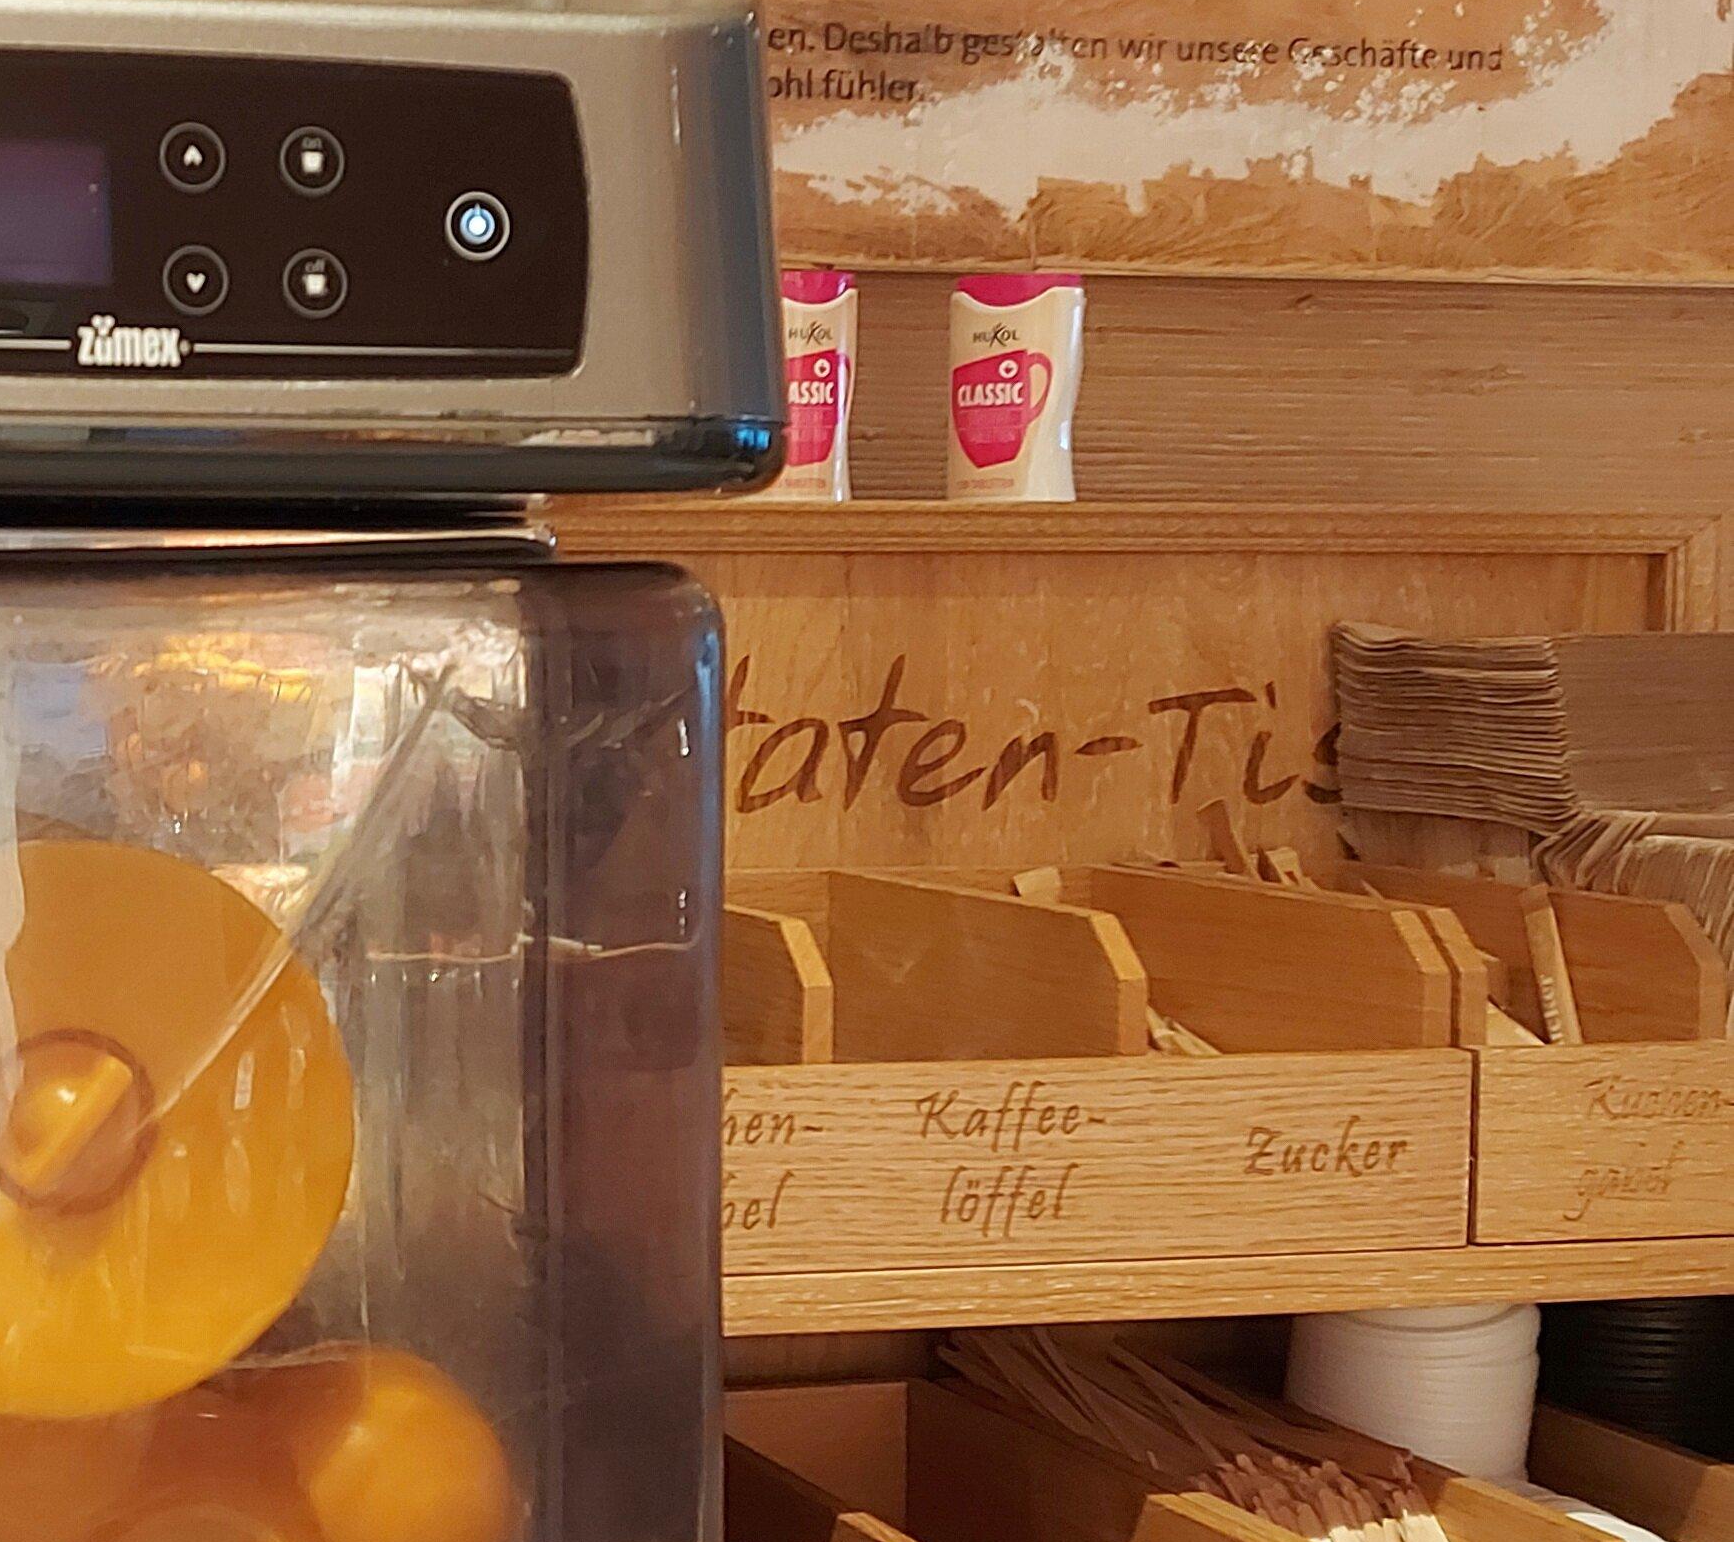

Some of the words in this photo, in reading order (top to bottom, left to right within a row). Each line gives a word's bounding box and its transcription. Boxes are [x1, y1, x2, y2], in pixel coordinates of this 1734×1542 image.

[77, 314, 181, 367] zümex
[788, 381, 834, 405] ASSIC
[958, 381, 1024, 408] CLASSIC
[915, 1081, 1108, 1152] Kaffee-
[1243, 1114, 1408, 1177] Zucker
[941, 1162, 1079, 1238] löffel
